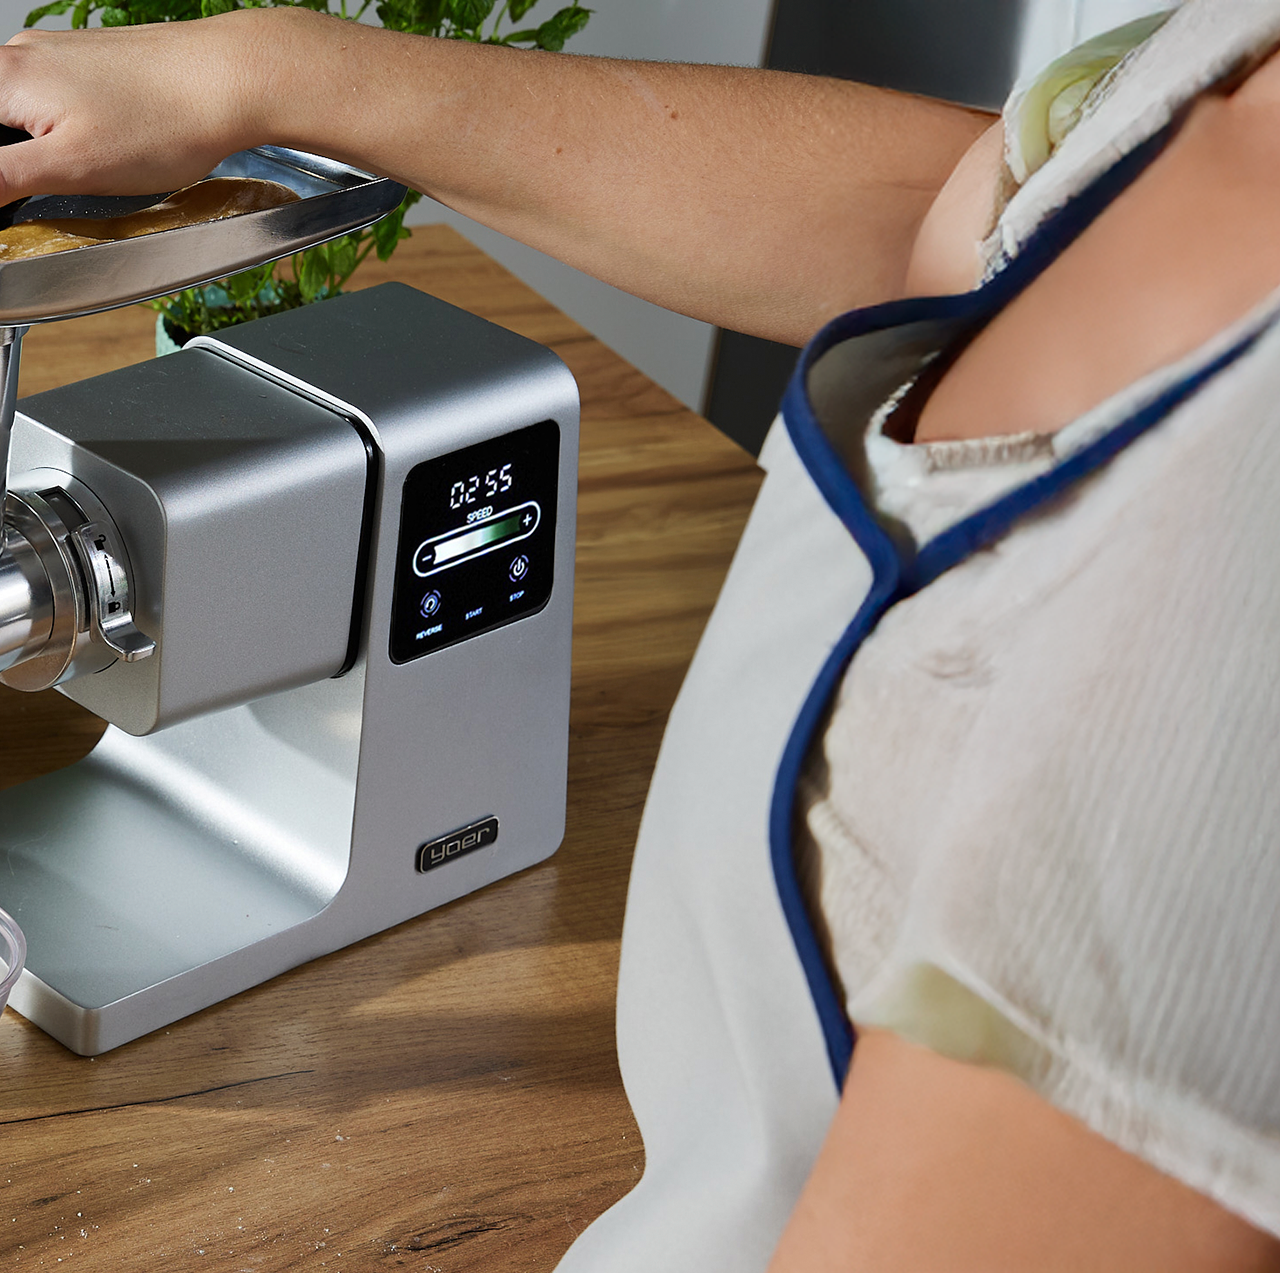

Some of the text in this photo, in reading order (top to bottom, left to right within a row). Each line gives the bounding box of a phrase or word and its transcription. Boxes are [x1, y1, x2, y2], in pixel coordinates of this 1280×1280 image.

[466, 506, 494, 524] SPEED
[509, 590, 524, 602] STOP
[465, 607, 483, 620] START
[415, 624, 443, 640] REVERSE
[430, 827, 490, 865] yoer
